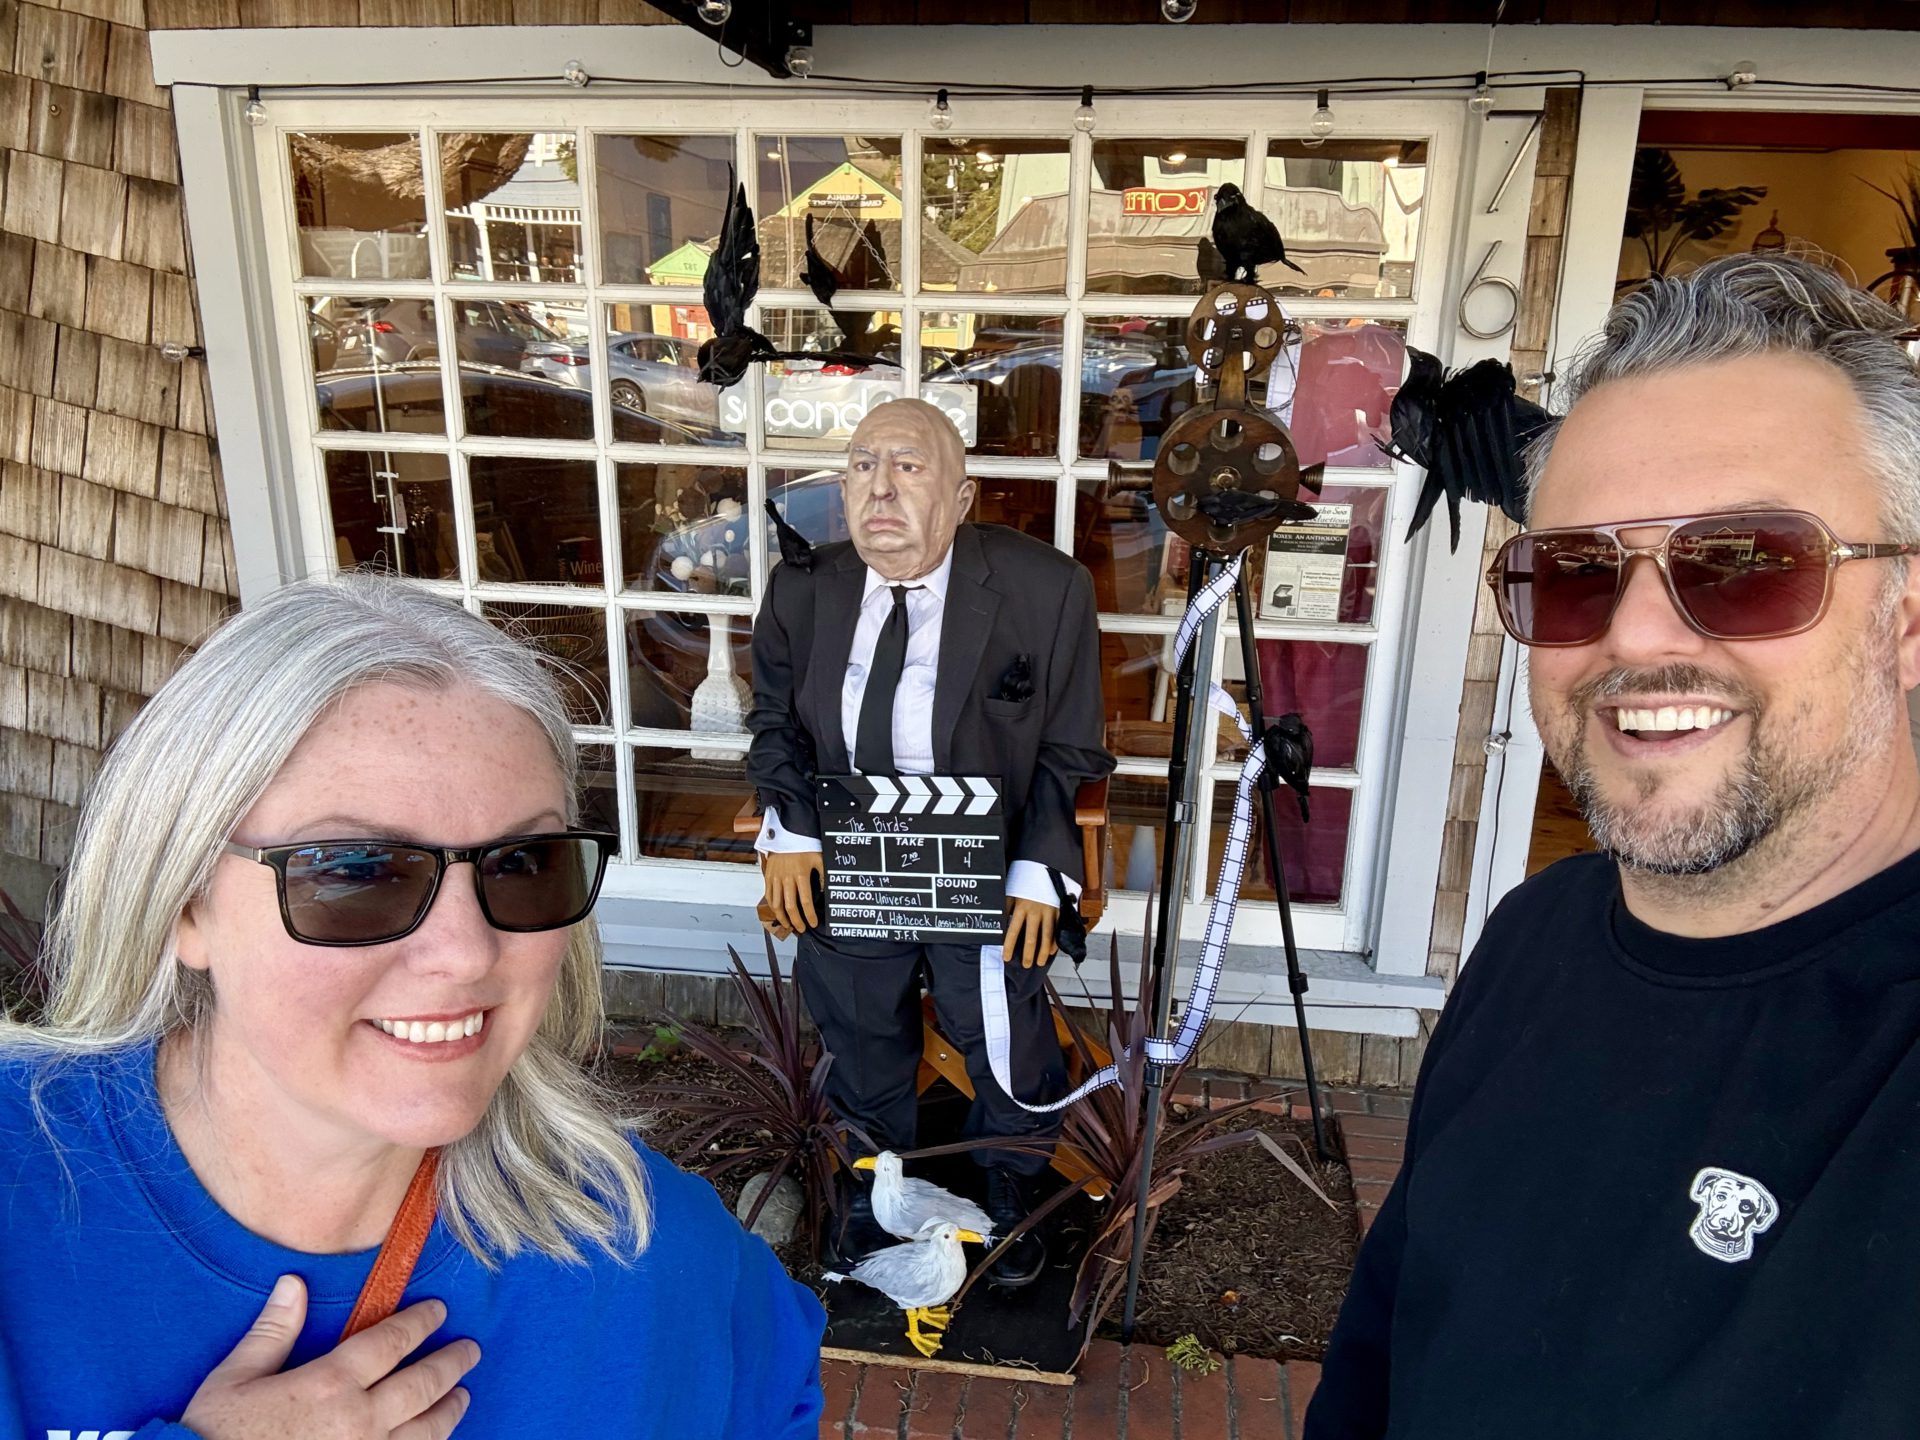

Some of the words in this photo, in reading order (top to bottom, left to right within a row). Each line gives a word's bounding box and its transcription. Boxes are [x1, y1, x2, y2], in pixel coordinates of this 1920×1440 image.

[725, 388, 868, 431] scond
[570, 560, 603, 576] Wine
[835, 836, 872, 846] SCENE
[895, 837, 925, 847] TAKE
[954, 838, 985, 848] ROLL
[834, 850, 857, 866] two
[963, 851, 971, 869] 4
[829, 875, 852, 883] DATE
[858, 875, 875, 887] Oct
[936, 878, 978, 889] SOUND
[830, 890, 875, 901] PROD.CO.
[874, 892, 922, 906] Universal
[950, 893, 982, 905] SYNC
[830, 908, 876, 918] DIRECTOR
[875, 910, 887, 925] A.
[831, 927, 889, 939] CAMERAMAN
